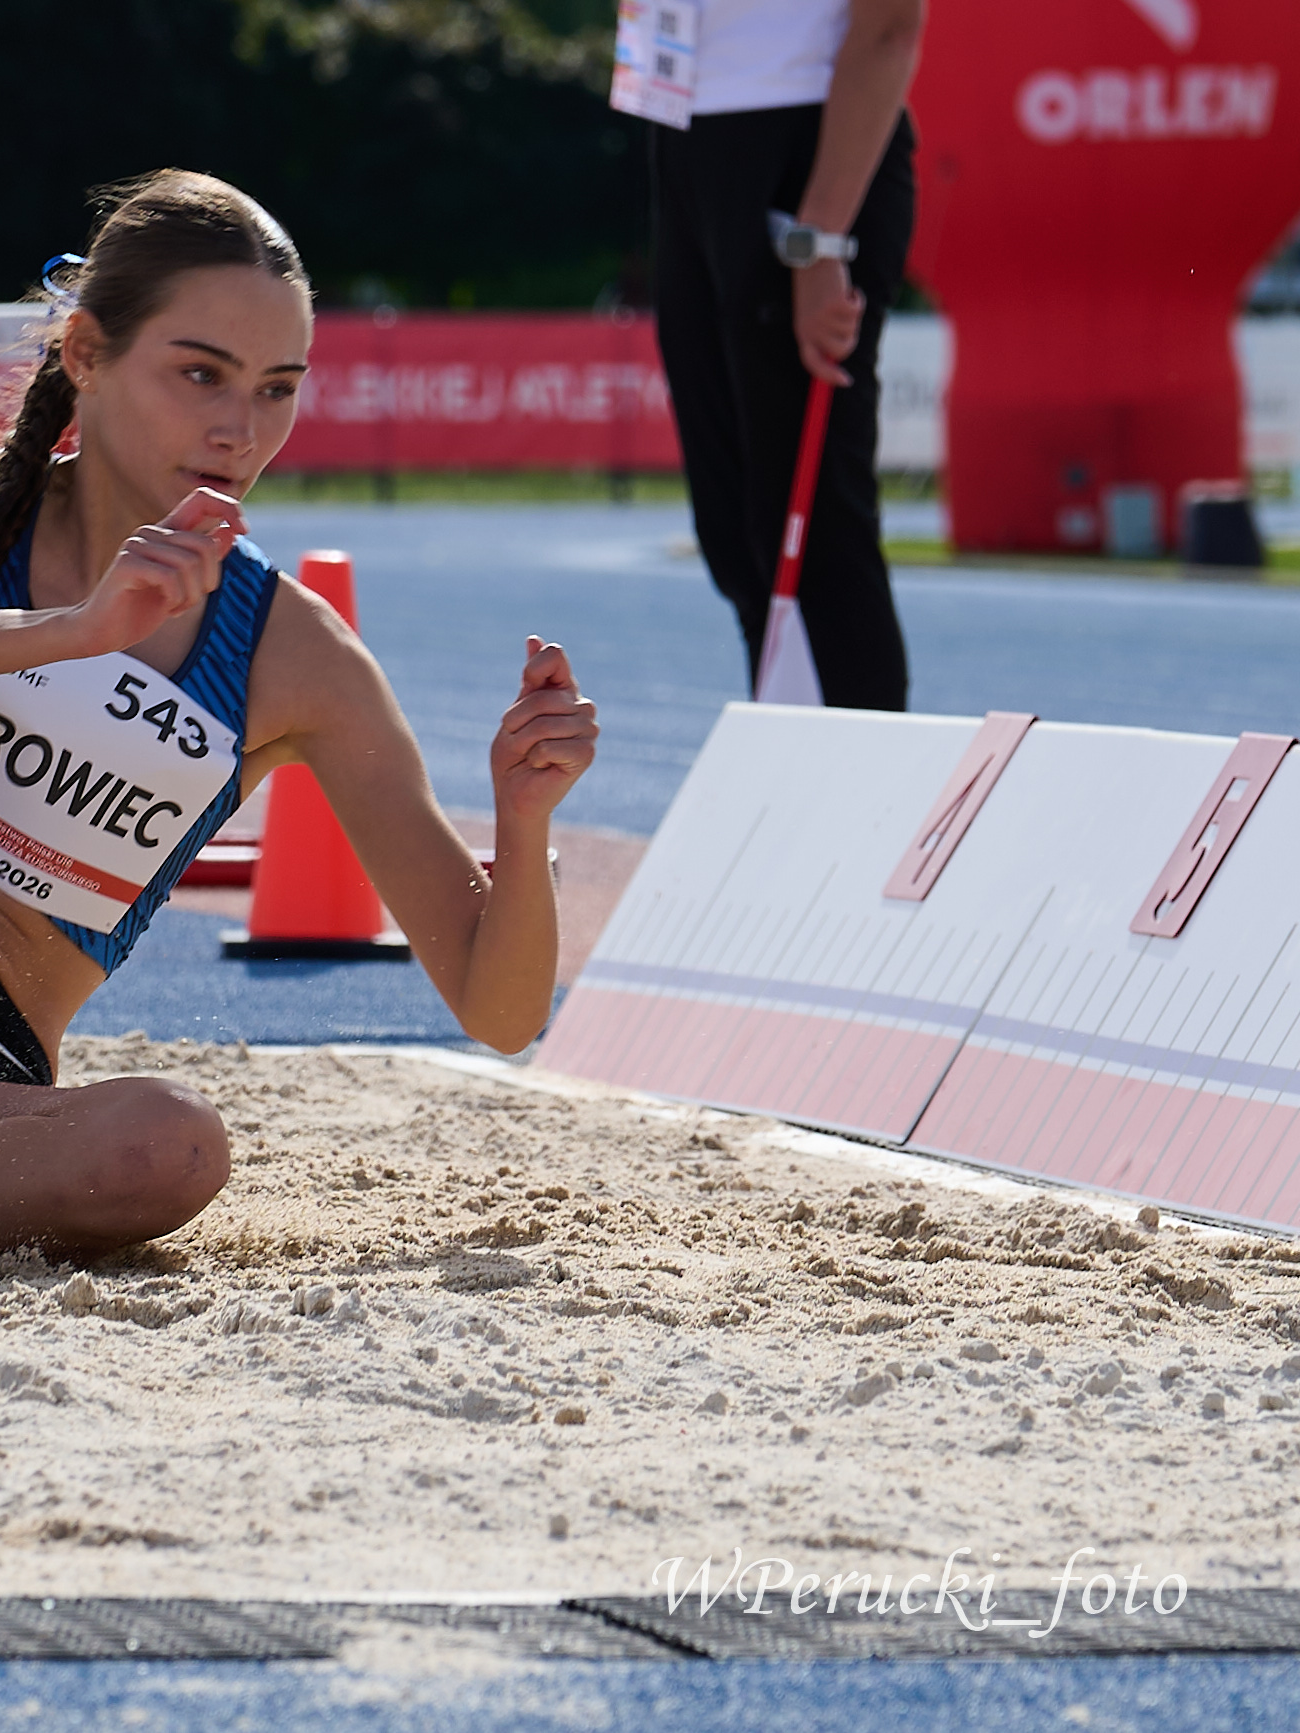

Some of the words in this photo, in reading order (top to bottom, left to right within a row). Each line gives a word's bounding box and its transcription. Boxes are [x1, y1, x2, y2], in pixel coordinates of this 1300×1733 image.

[1015, 67, 1278, 143] ORLEN
[104, 672, 209, 759] 543
[911, 752, 997, 886] 4
